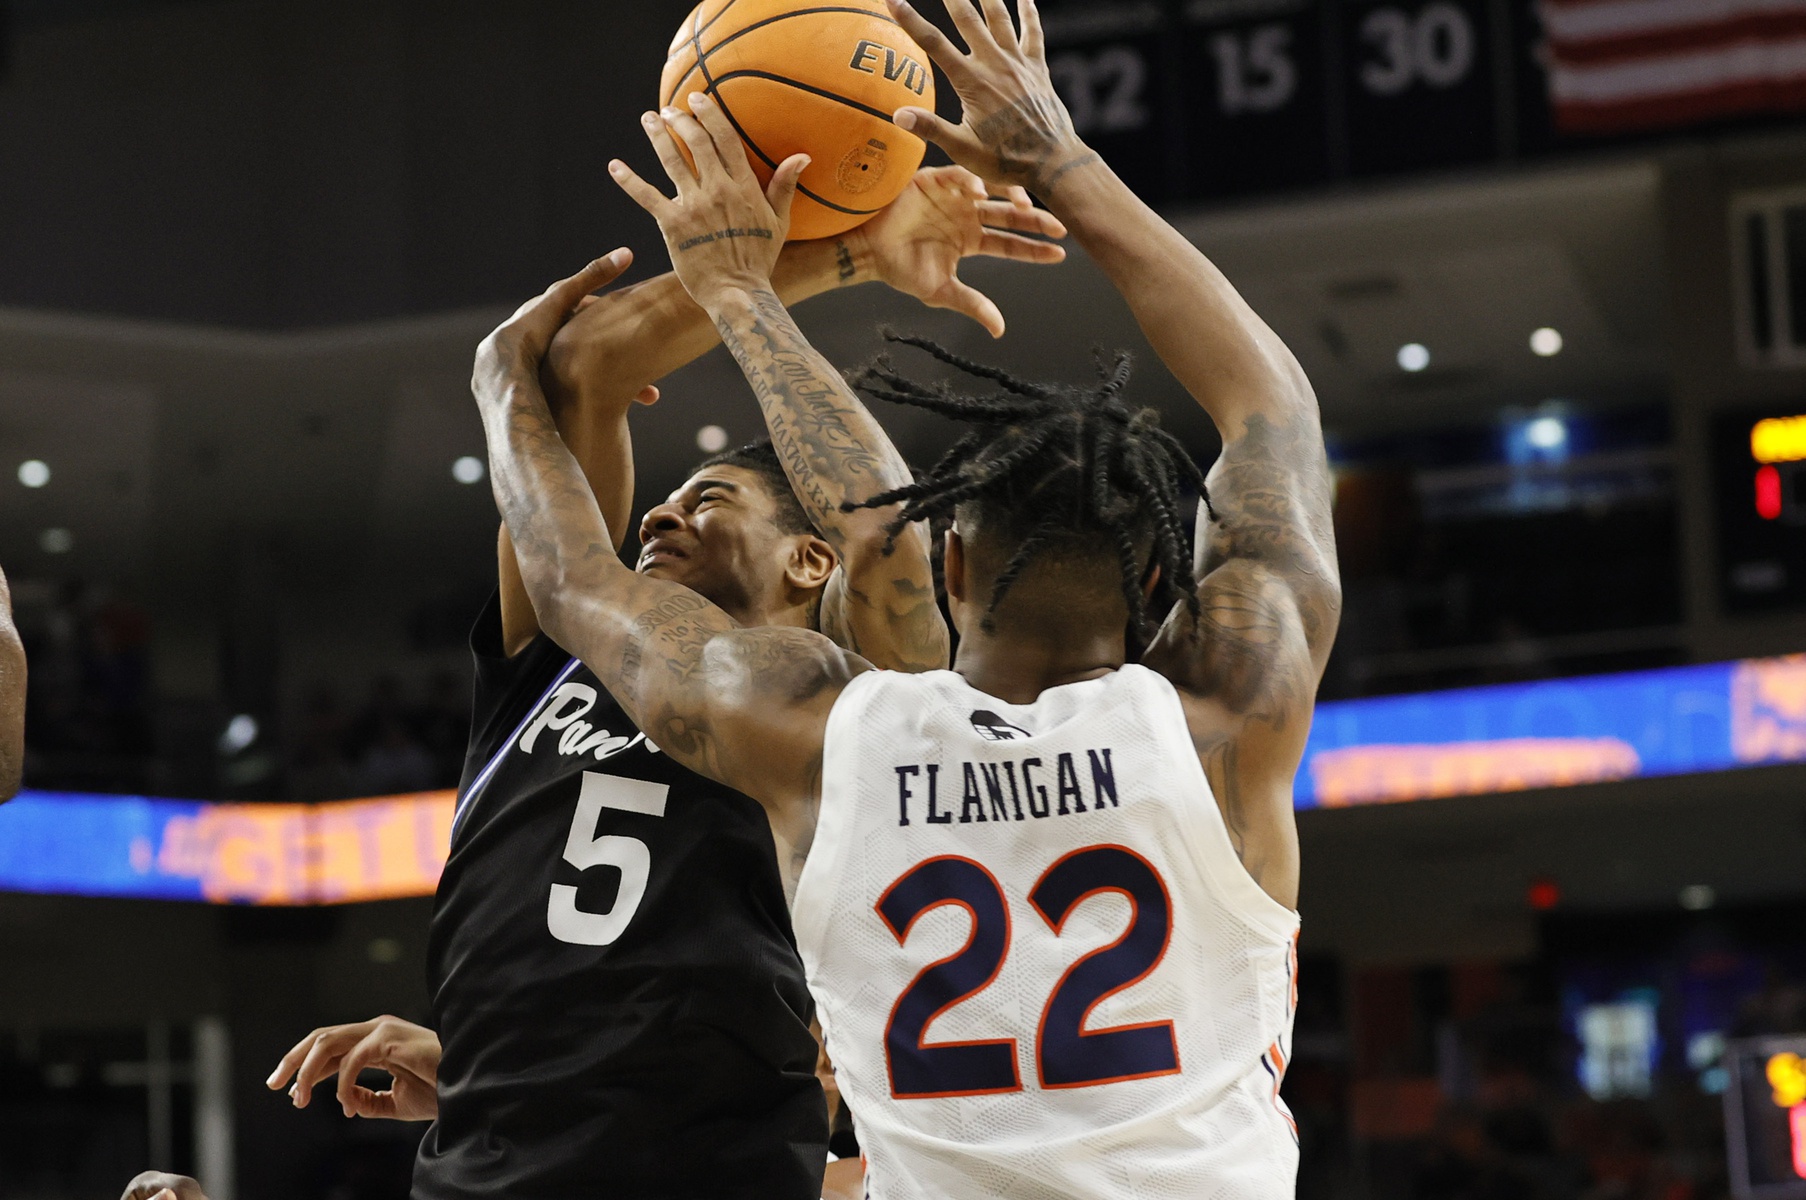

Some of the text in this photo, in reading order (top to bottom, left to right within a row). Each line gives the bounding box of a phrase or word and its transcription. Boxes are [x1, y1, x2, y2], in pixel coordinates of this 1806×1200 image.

[850, 40, 926, 96] EVO
[1209, 27, 1297, 115] 15
[1363, 5, 1474, 93] 30
[894, 748, 1120, 826] FLANIGAN
[547, 770, 670, 946] 5
[873, 843, 1182, 1100] 22
